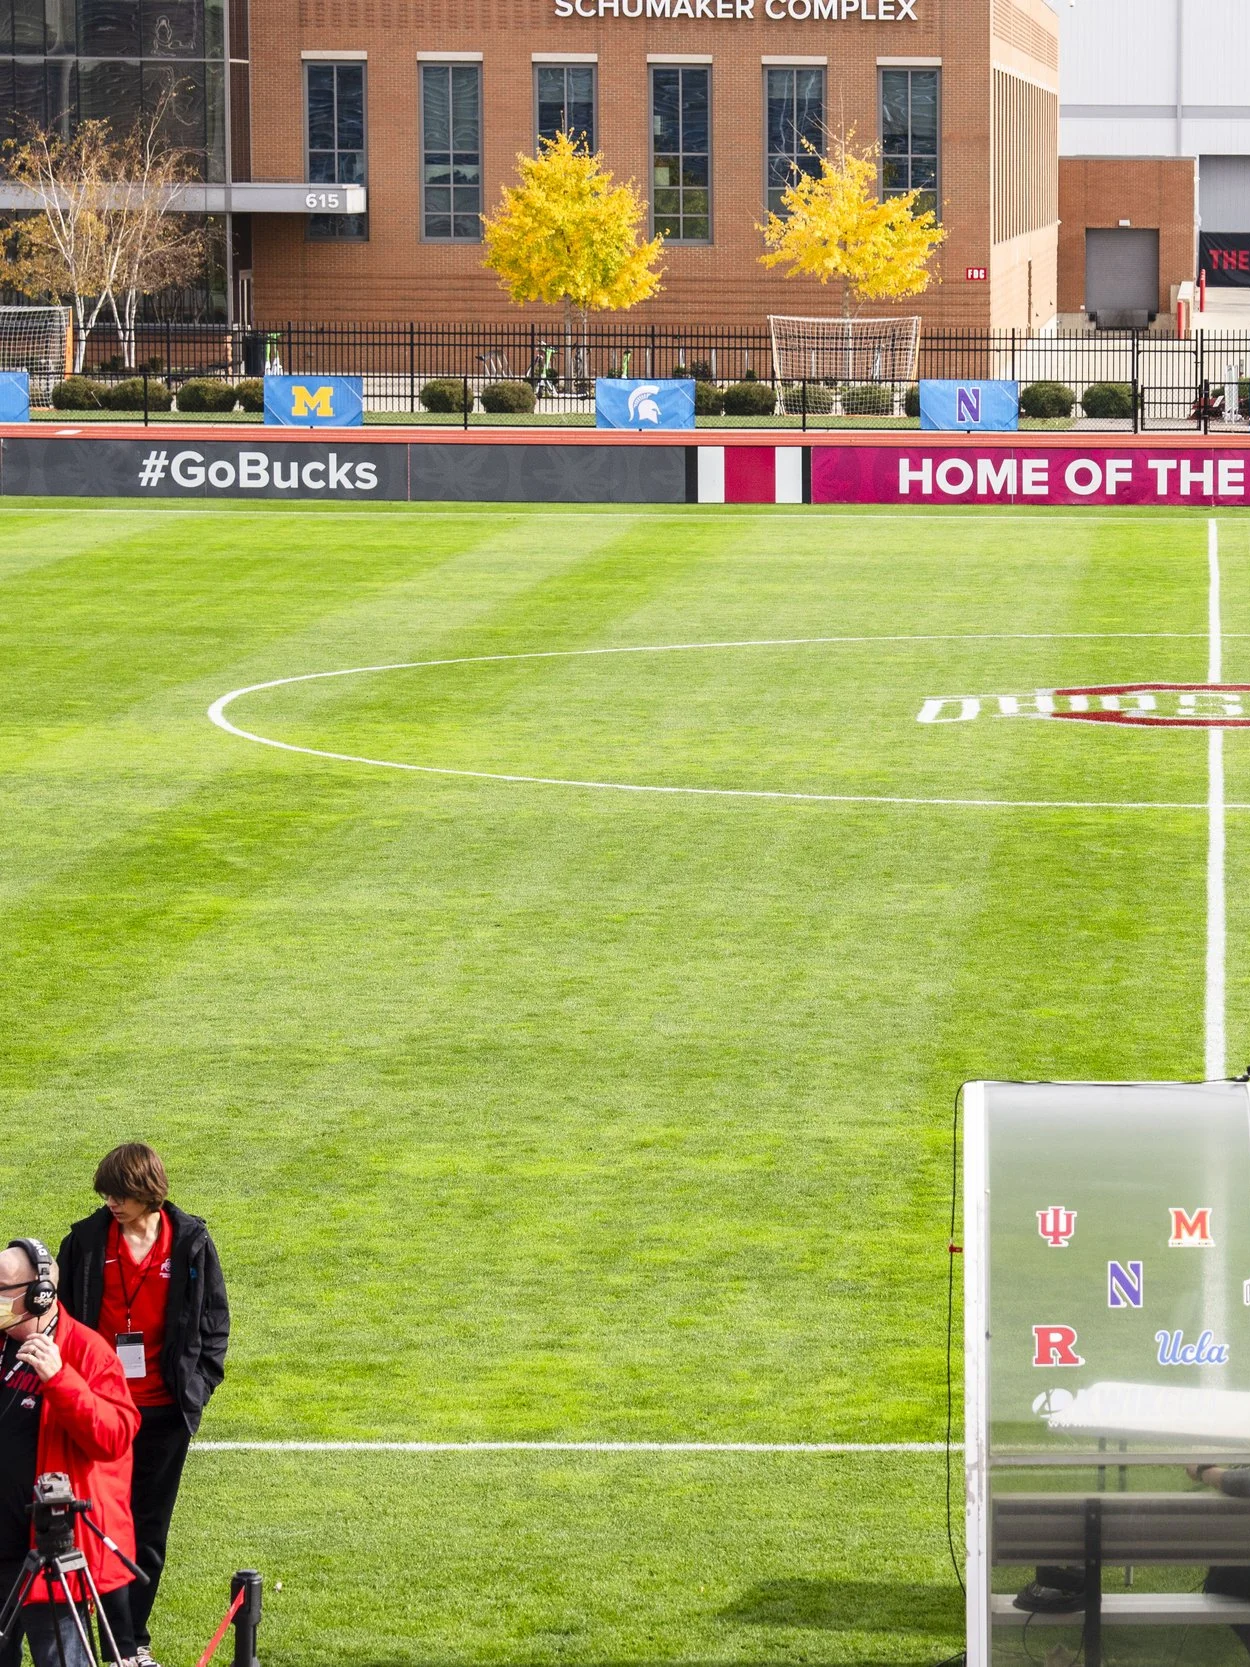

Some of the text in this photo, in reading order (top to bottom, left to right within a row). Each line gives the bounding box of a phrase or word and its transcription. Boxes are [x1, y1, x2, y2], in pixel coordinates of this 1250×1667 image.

[554, 0, 918, 21] SCHUMAKER COMPLEX
[305, 193, 339, 209] 615
[1209, 249, 1250, 271] THE
[291, 385, 334, 417] M
[956, 387, 981, 423] N
[138, 450, 379, 490] #GoBucks
[897, 458, 1049, 496] HOME
[1064, 458, 1133, 496] OF
[1147, 459, 1245, 496] THE
[1171, 1210, 1209, 1240] M
[1108, 1262, 1142, 1307] N
[1033, 1326, 1080, 1366] R
